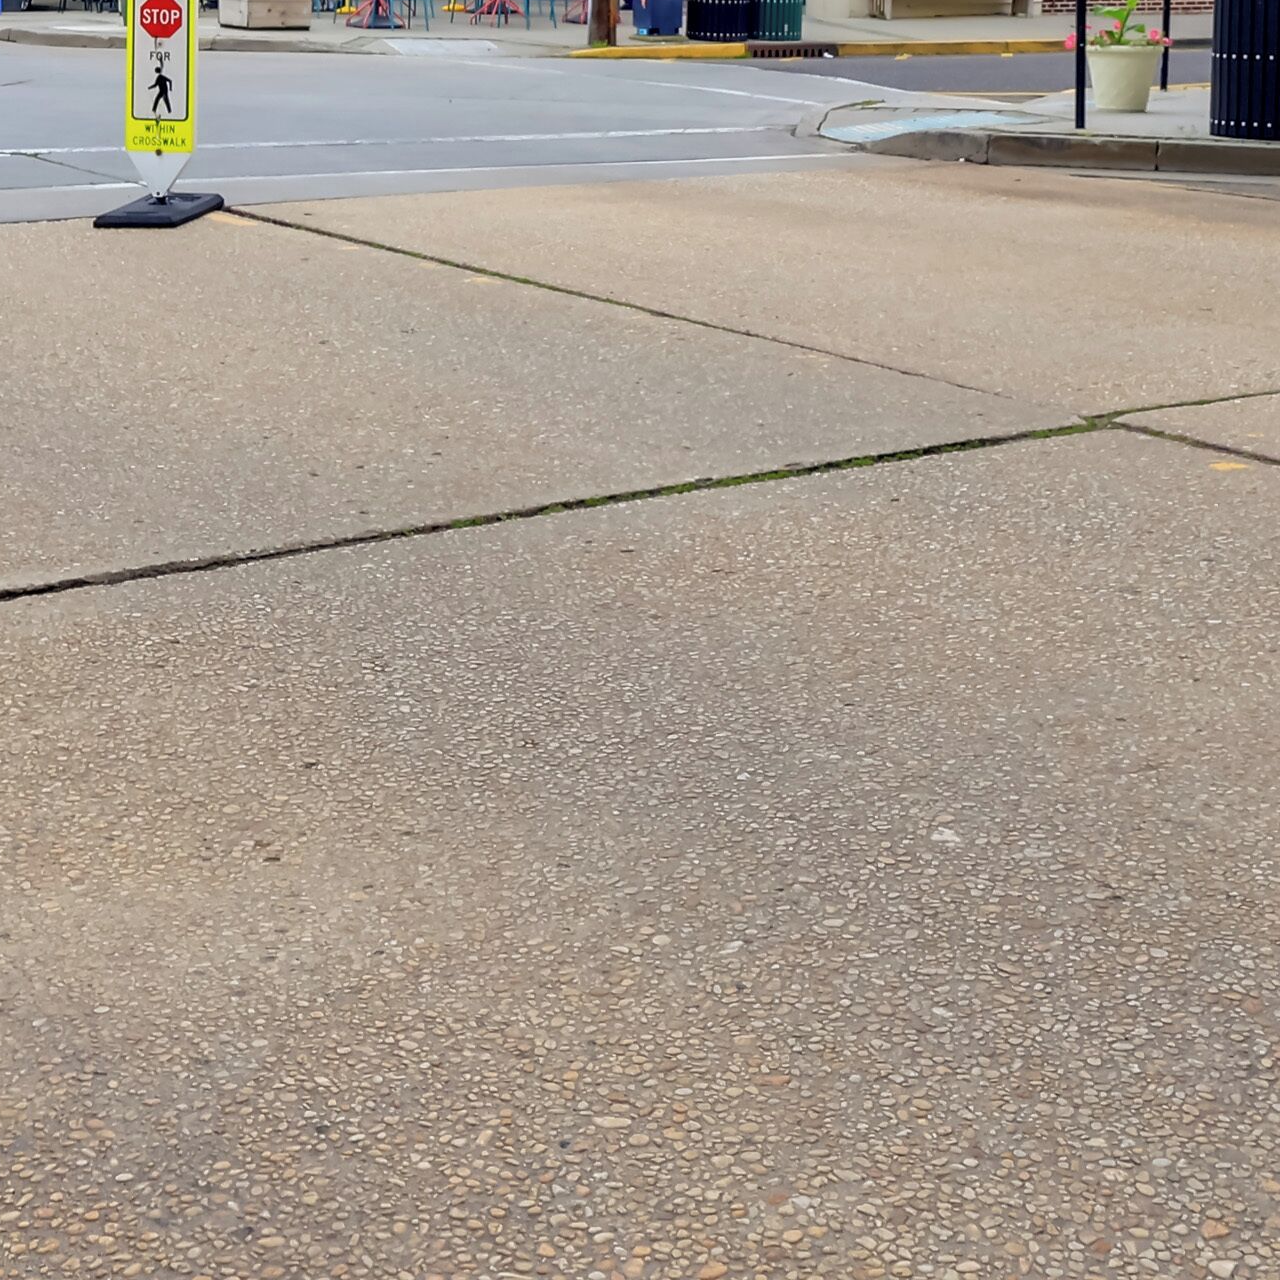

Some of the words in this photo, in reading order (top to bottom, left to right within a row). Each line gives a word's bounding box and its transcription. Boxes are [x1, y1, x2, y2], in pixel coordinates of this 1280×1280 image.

[142, 8, 180, 25] STOP
[149, 51, 171, 62] FOR
[132, 136, 187, 147] CROSSWALK
